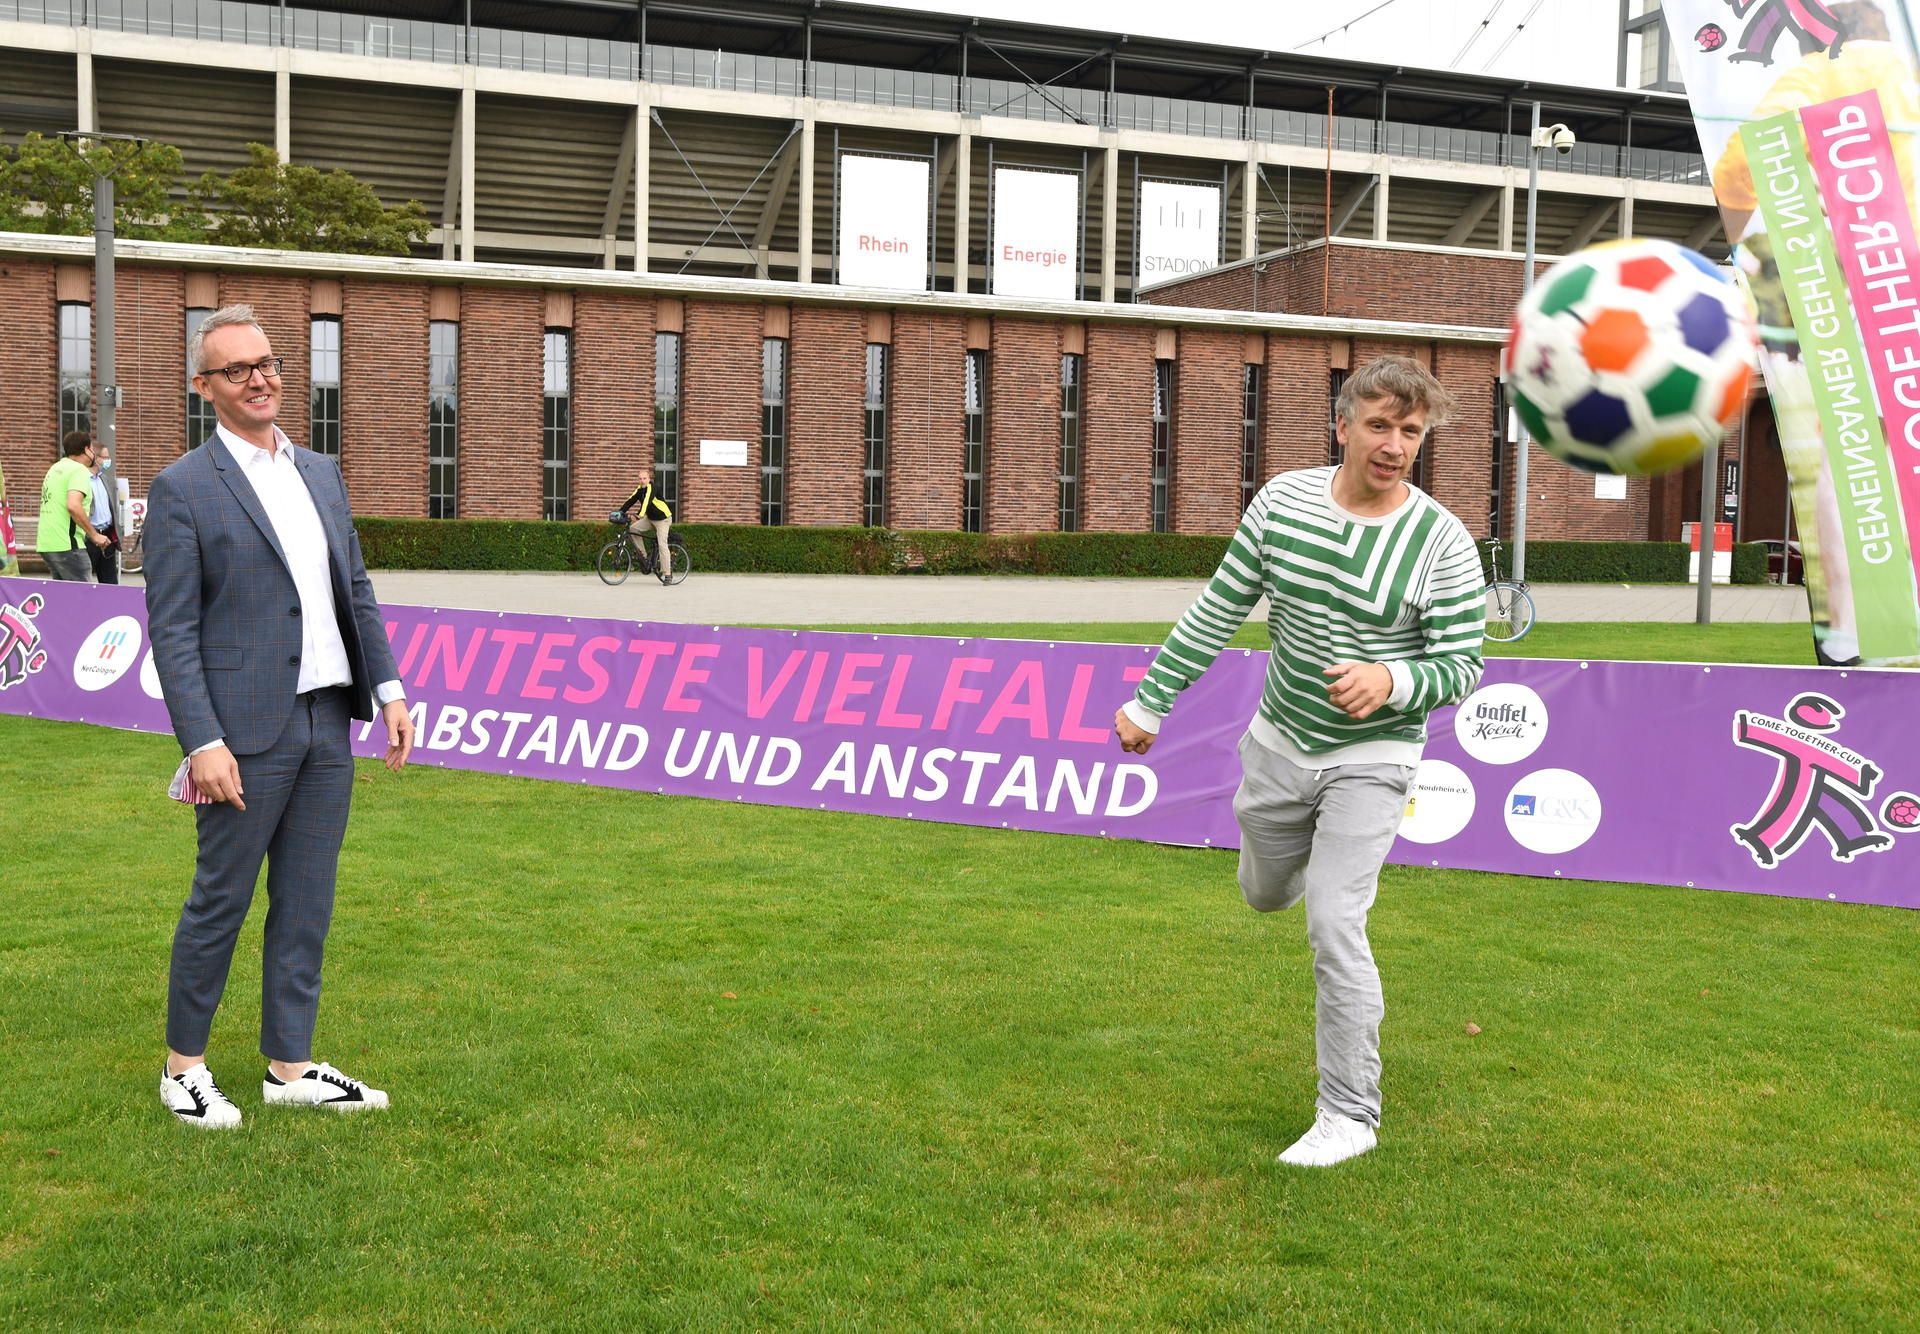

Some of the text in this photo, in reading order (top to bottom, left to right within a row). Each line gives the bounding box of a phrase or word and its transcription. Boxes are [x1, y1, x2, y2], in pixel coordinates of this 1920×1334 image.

[859, 234, 909, 254] Rhein
[1003, 246, 1067, 266] Energie
[1144, 255, 1213, 275] STADION
[81, 664, 116, 676] NetCologne
[384, 622, 720, 714] UNTESTE
[1476, 702, 1527, 723] Gaffel
[1750, 716, 1861, 766] COME-TOGETHER-CUP
[408, 701, 649, 771] ABSTAND
[663, 727, 802, 787] UND
[810, 741, 1159, 817] ANSTAND
[1418, 784, 1455, 793] Nordrhein
